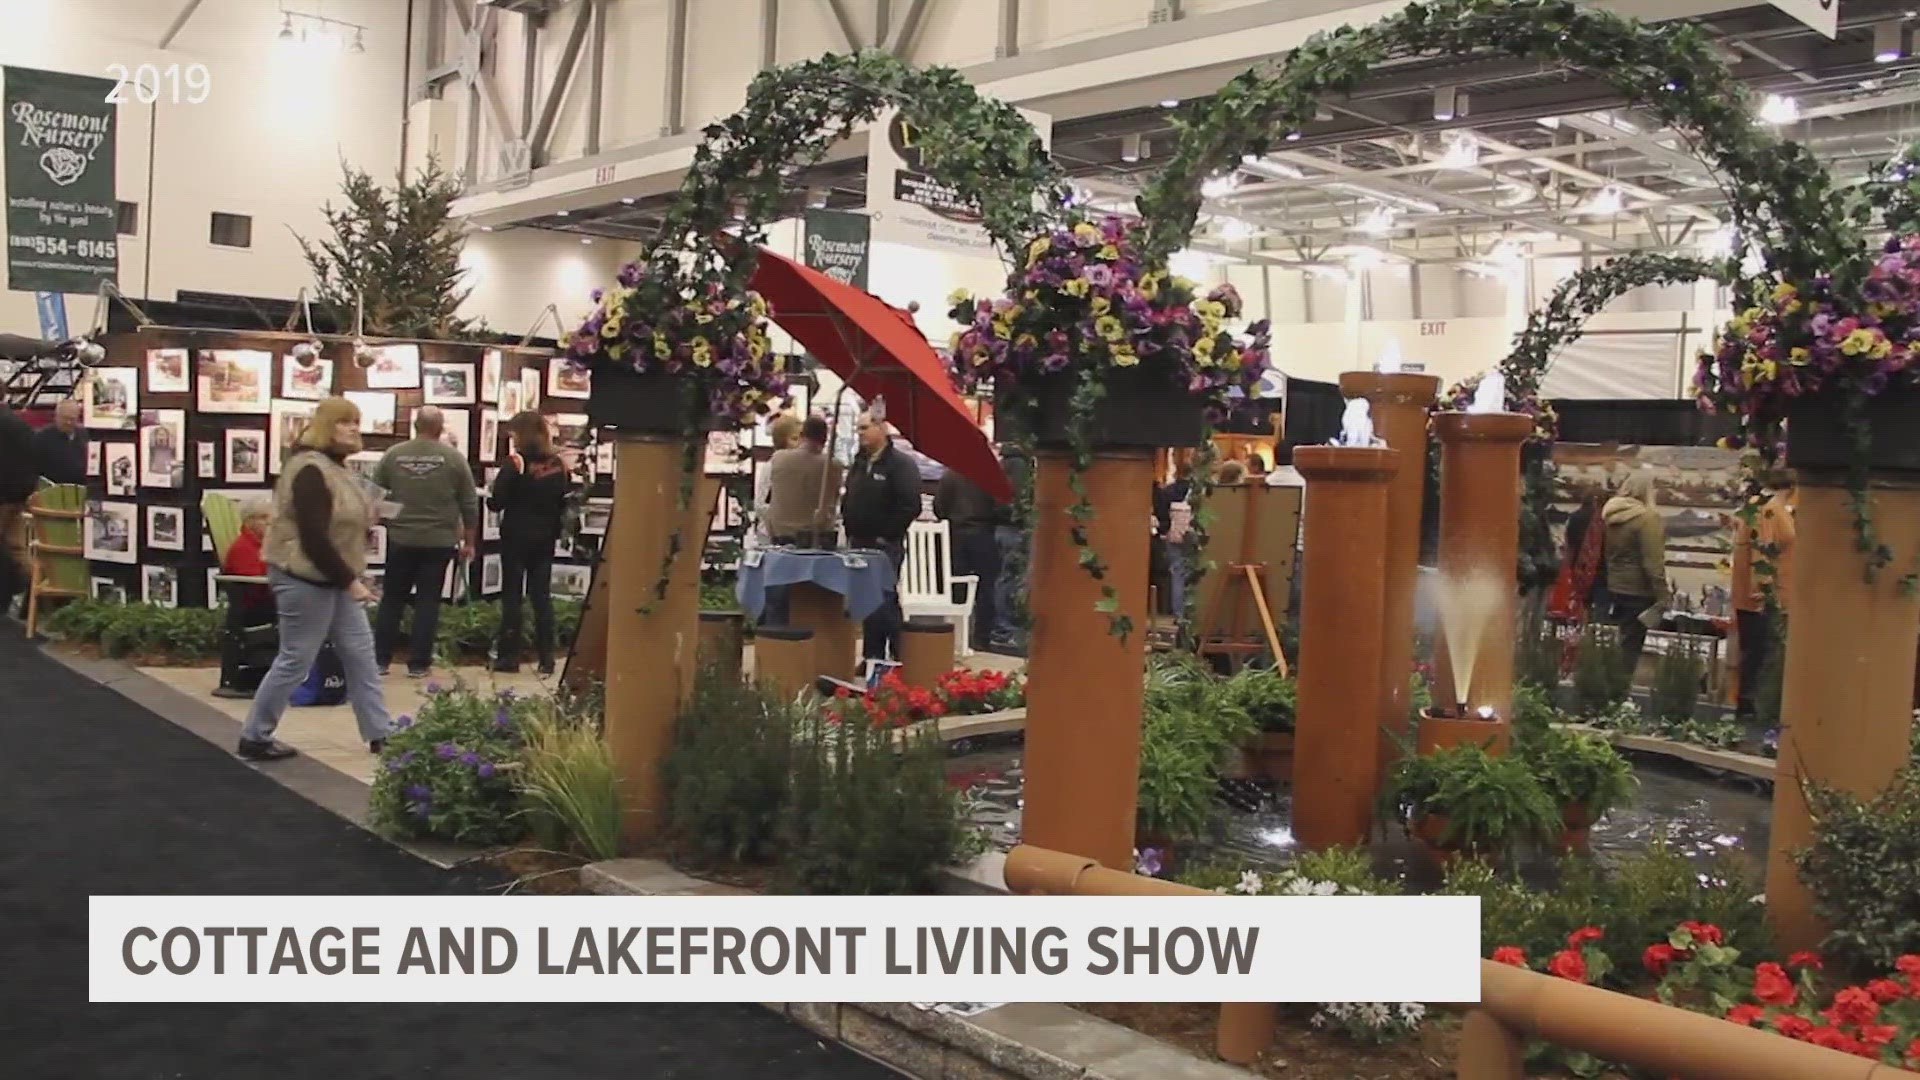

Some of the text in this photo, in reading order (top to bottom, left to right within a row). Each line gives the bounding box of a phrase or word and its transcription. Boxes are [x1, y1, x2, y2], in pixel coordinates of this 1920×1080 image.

[11, 101, 110, 133] Rosemont
[20, 125, 105, 160] Nursery
[808, 234, 867, 256] Rosemont
[812, 251, 863, 277] Nursery
[1420, 321, 1447, 336] EXIT
